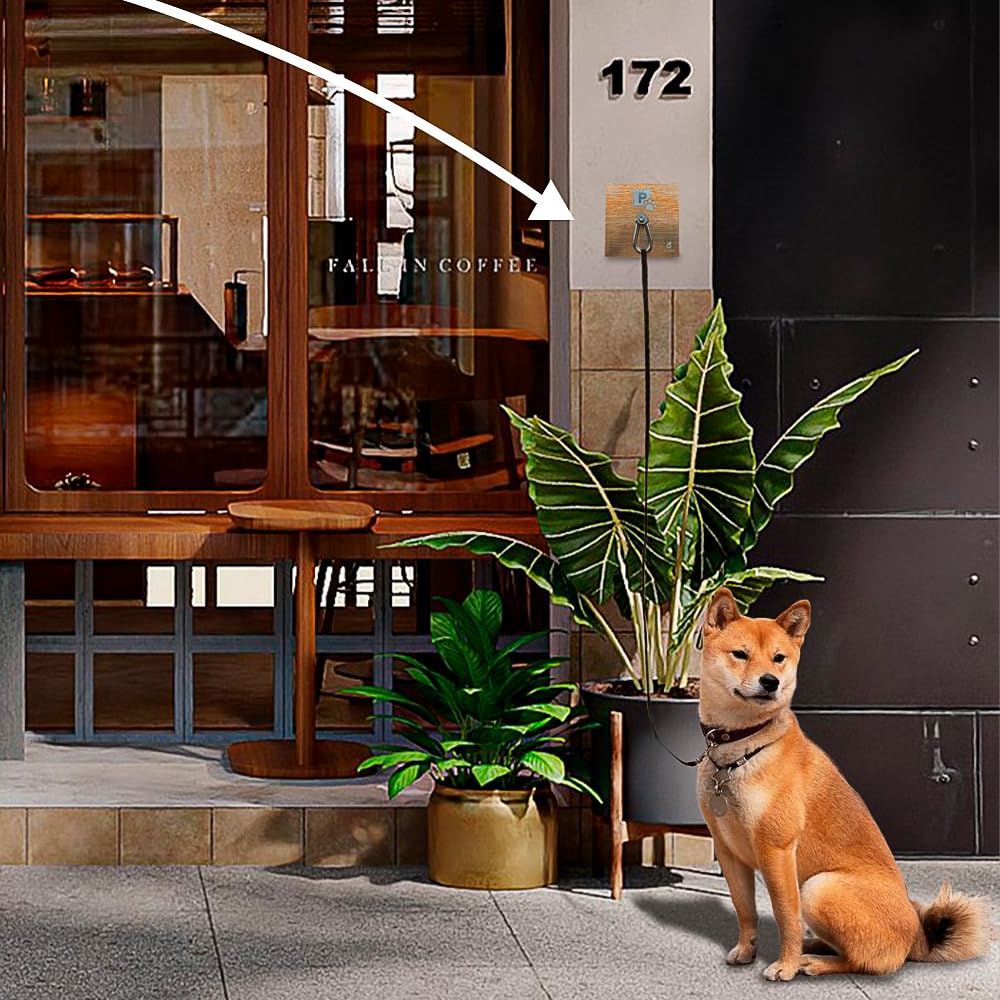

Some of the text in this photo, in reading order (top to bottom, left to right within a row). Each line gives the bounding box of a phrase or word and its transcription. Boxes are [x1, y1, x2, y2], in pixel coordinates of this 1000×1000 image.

[600, 58, 693, 100] 172
[402, 258, 427, 273] IN
[439, 258, 537, 273] COFFEE
